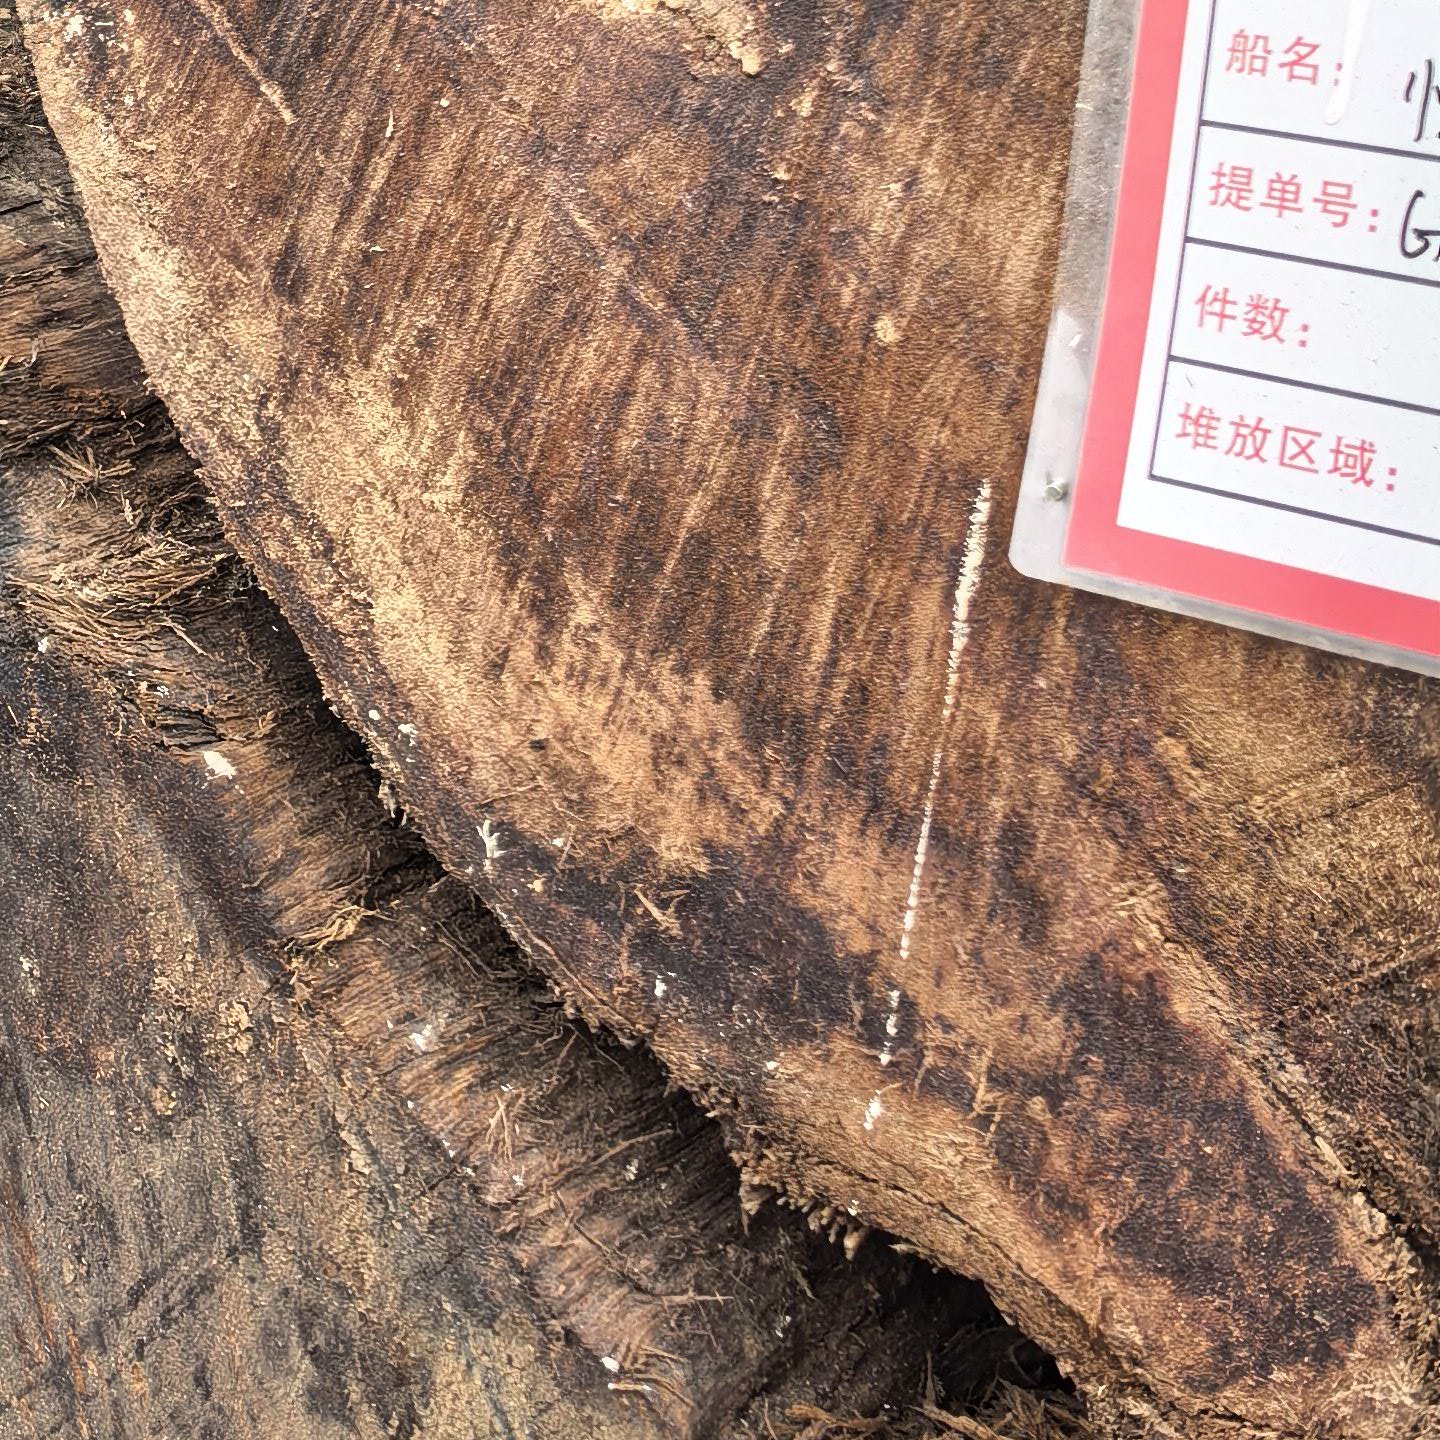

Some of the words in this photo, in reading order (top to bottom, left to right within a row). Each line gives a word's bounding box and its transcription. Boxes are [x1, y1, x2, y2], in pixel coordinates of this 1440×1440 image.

[1208, 161, 1380, 233] 提单号：
[1194, 284, 1310, 349] 件数：
[1177, 402, 1398, 492] 堆放区域：
